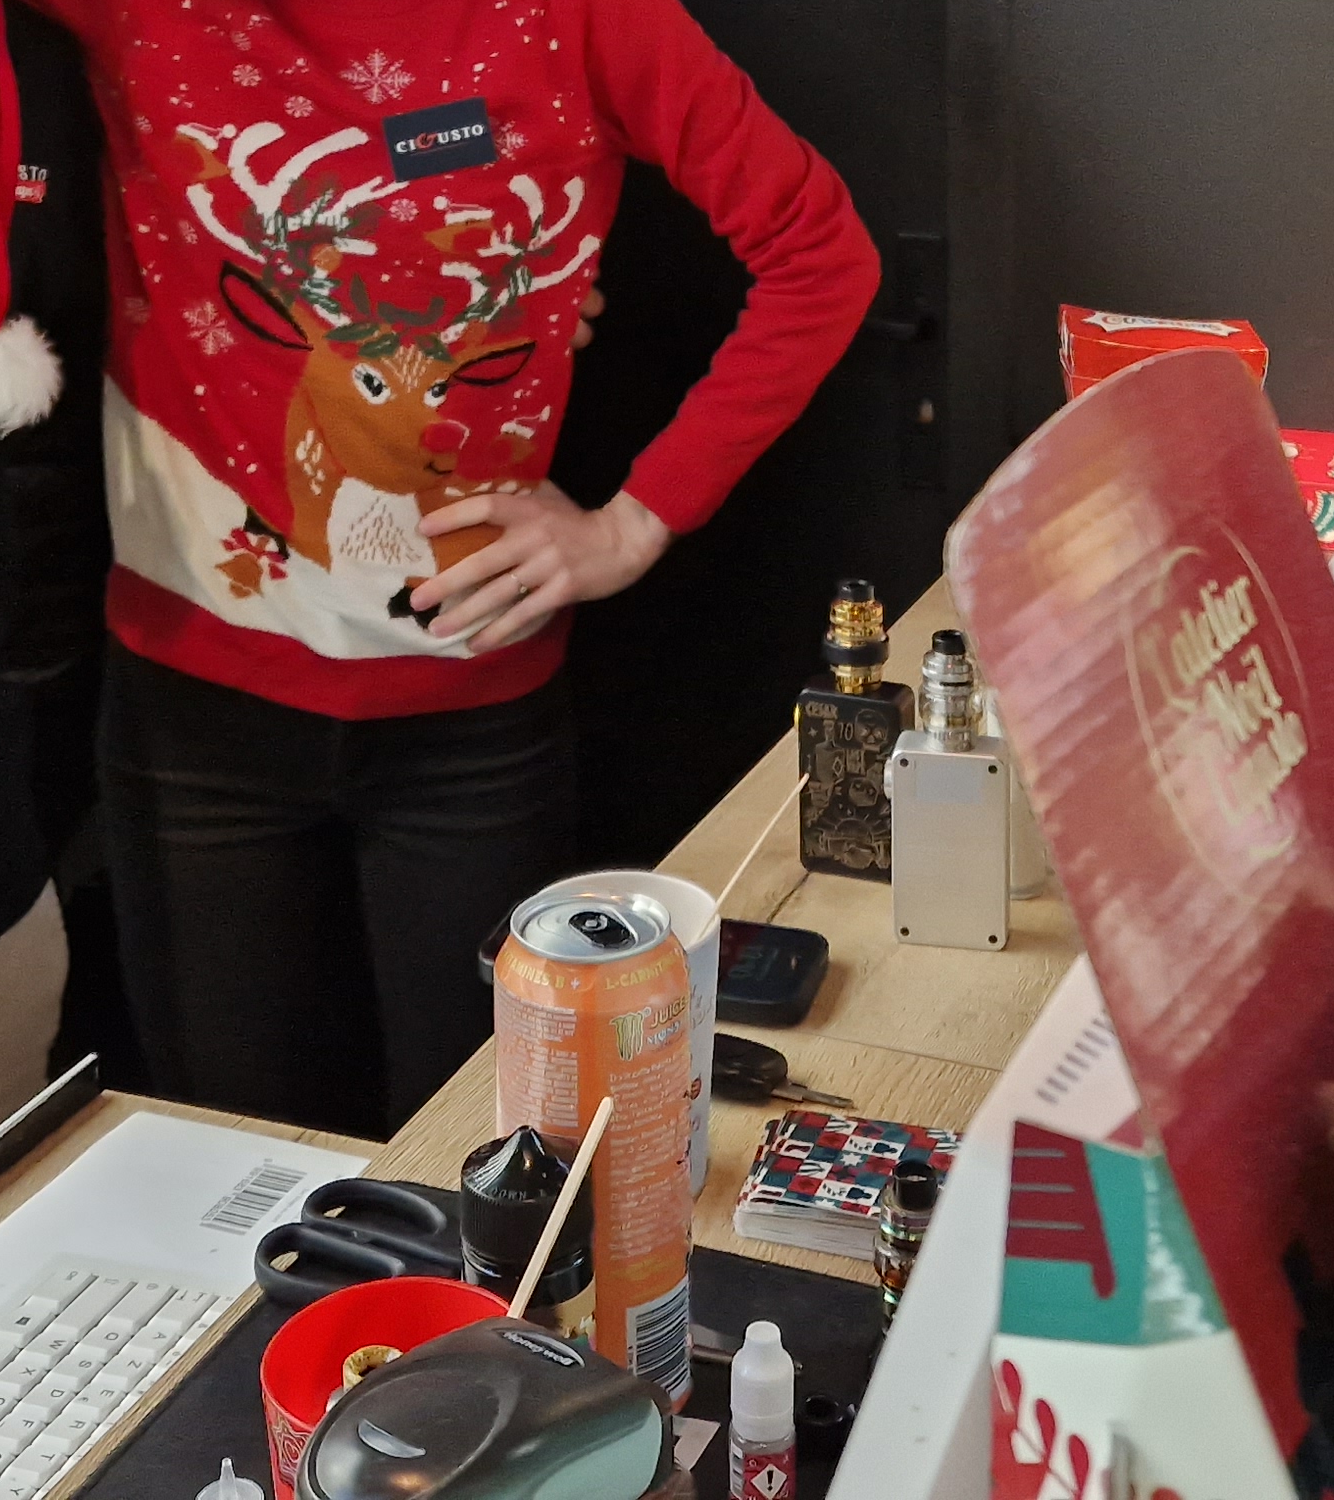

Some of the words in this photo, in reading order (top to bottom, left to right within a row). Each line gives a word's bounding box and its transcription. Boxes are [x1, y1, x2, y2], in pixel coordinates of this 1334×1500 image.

[395, 123, 485, 154] CIGUSTO
[838, 721, 854, 742] 10
[104, 1332, 119, 1342] Q
[153, 1332, 166, 1341] A
[49, 1339, 65, 1350] W
[78, 1360, 92, 1369] S
[128, 1359, 142, 1369] Z
[22, 1367, 36, 1377] X
[51, 1388, 64, 1399] D
[100, 1388, 114, 1399] E
[21, 1418, 35, 1429] F
[69, 1419, 84, 1430] R
[40, 1453, 55, 1462] T
[10, 1485, 24, 1497] Y
